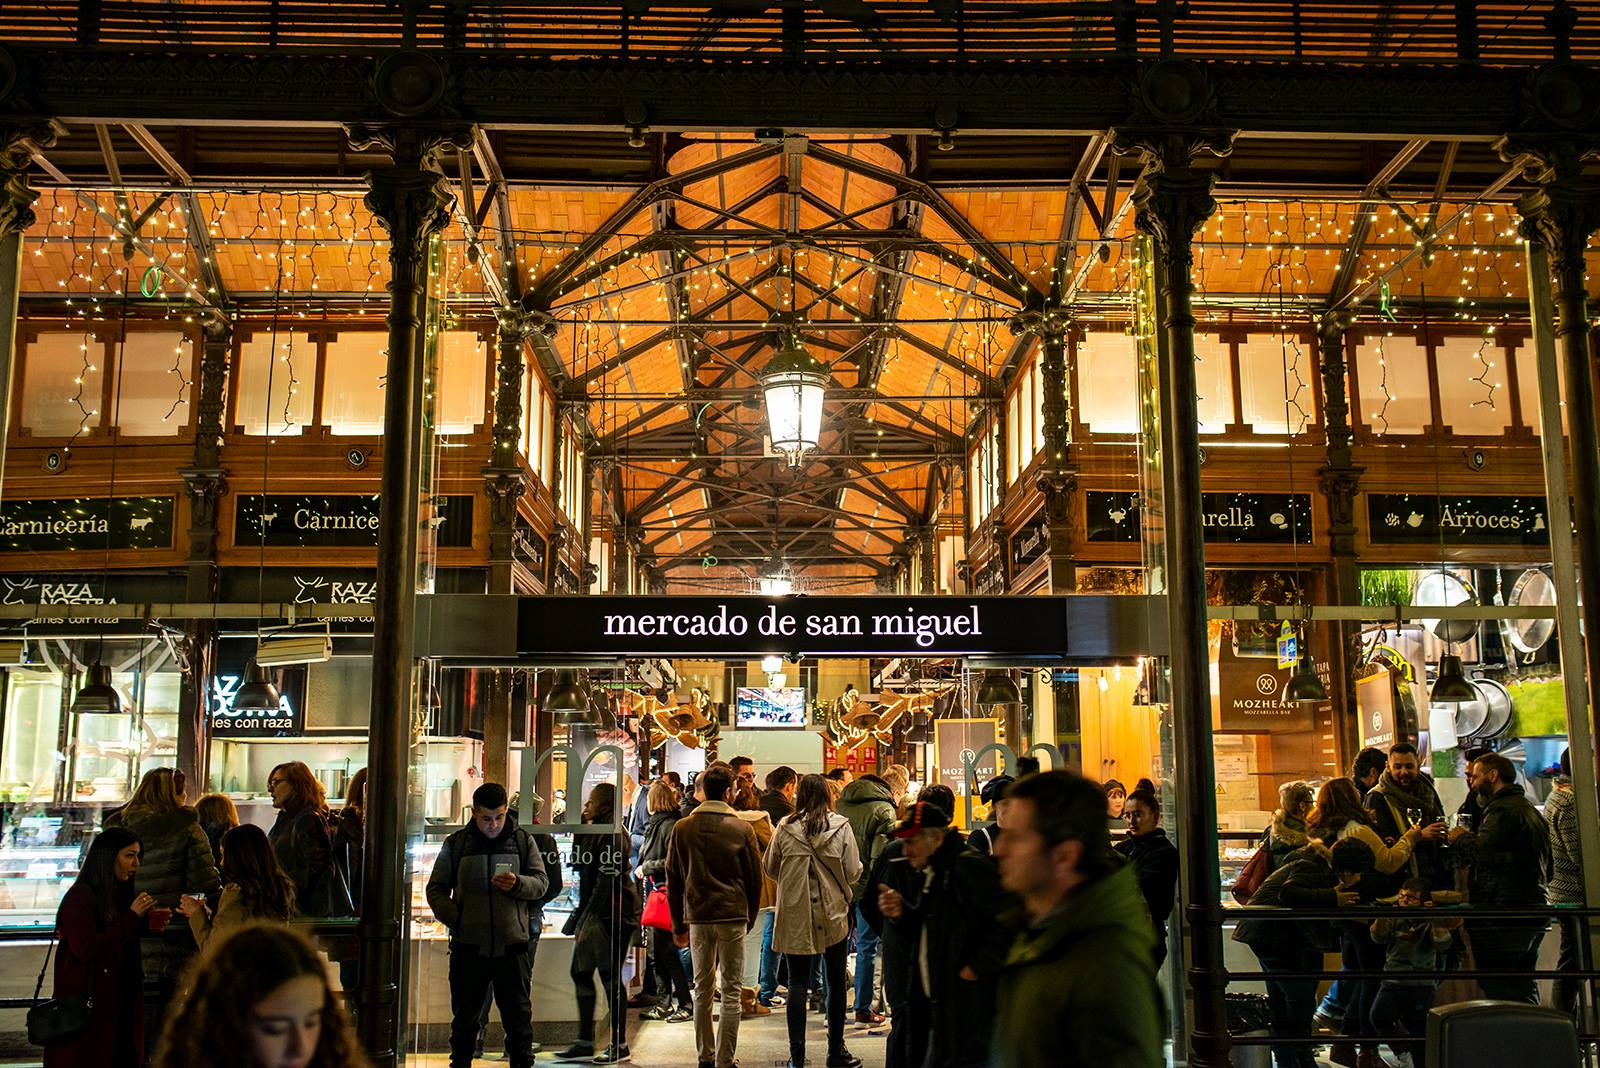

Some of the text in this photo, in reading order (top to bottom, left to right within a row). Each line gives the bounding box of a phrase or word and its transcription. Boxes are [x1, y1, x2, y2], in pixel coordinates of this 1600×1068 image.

[49, 456, 56, 465] 6
[351, 452, 359, 461] 7
[1476, 454, 1482, 463] 9
[1438, 508, 1521, 529] Arroces
[41, 583, 93, 598] RAZA
[604, 605, 982, 647] mercado de san miguel
[235, 719, 259, 728] con
[263, 719, 293, 728] raza
[942, 767, 994, 776] MOZART
[600, 845, 623, 865] de
